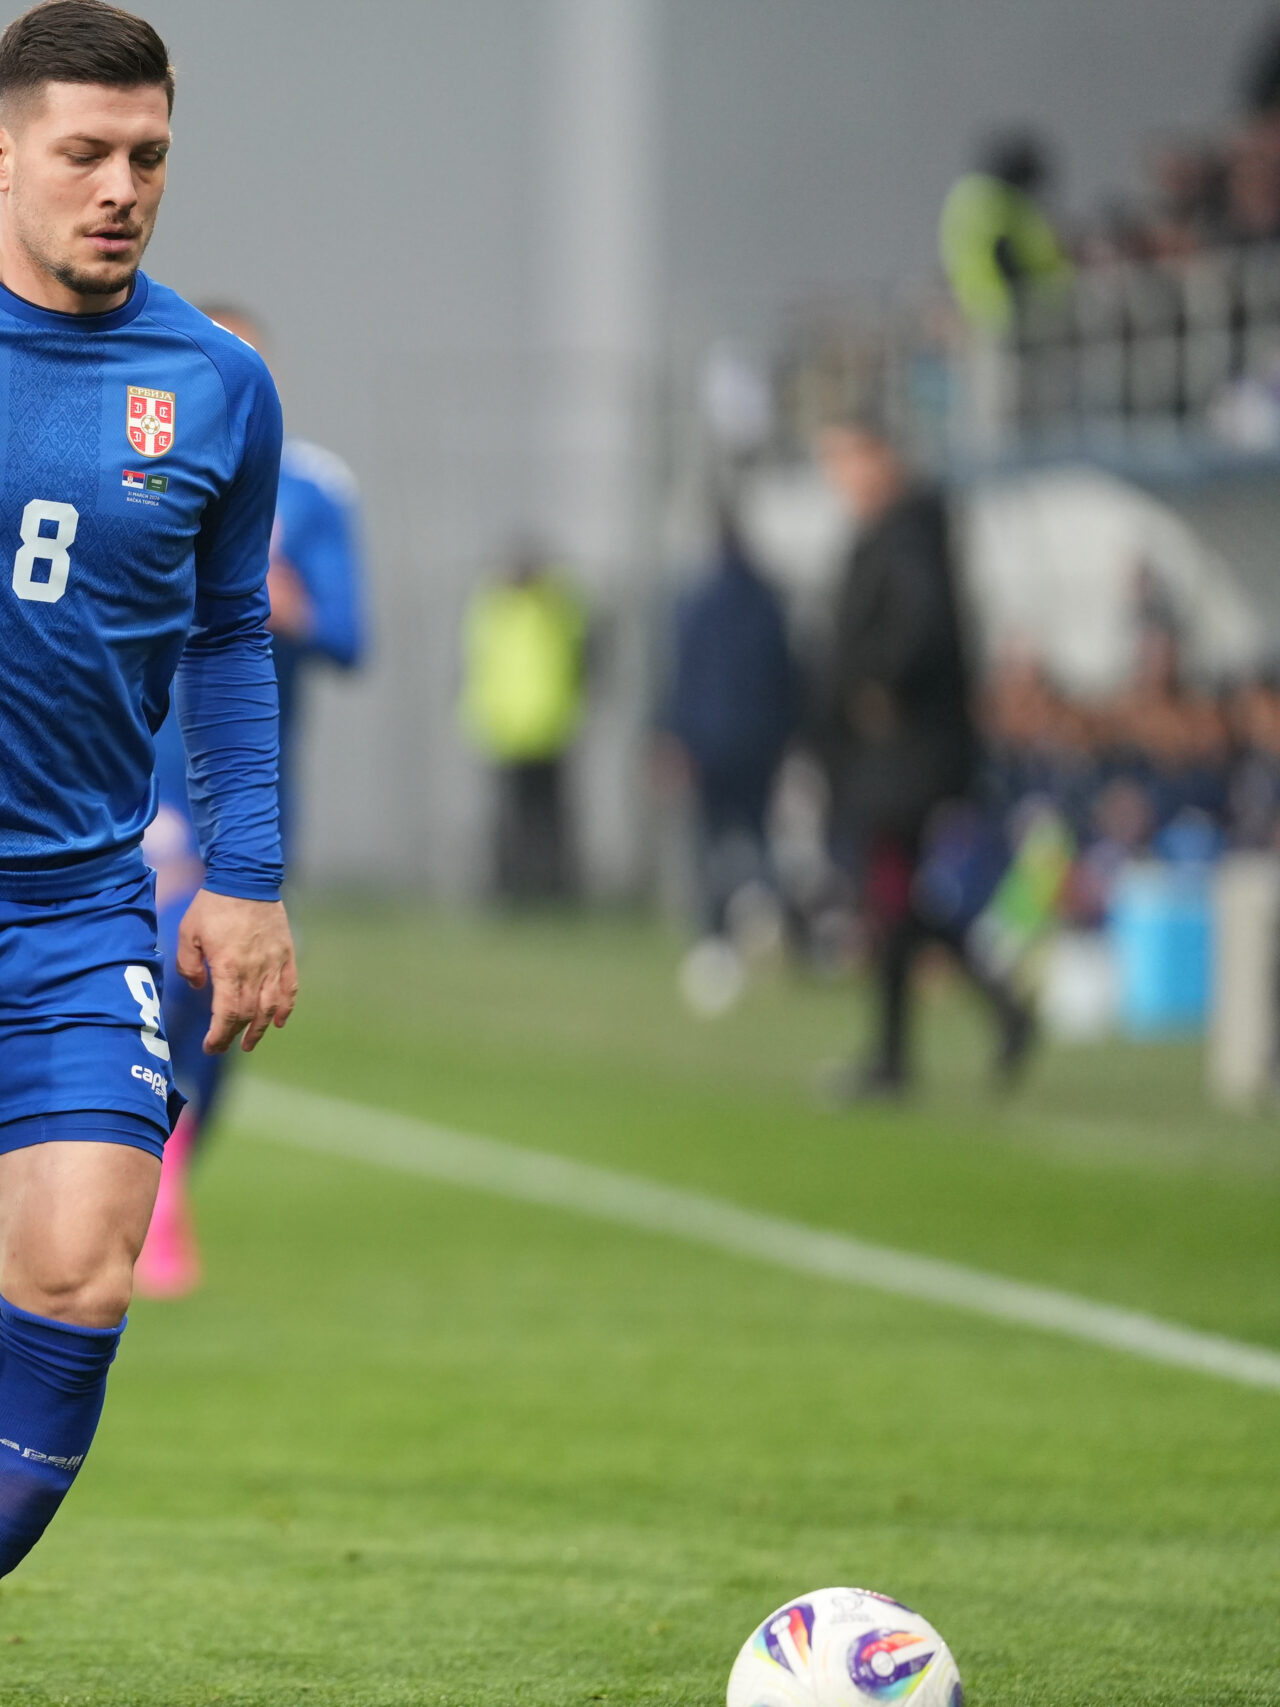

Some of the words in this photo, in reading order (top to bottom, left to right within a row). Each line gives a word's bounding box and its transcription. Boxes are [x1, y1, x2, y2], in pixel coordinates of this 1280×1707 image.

[130, 387, 173, 401] СРБИЈА
[12, 499, 80, 603] 8
[124, 965, 171, 1062] 8
